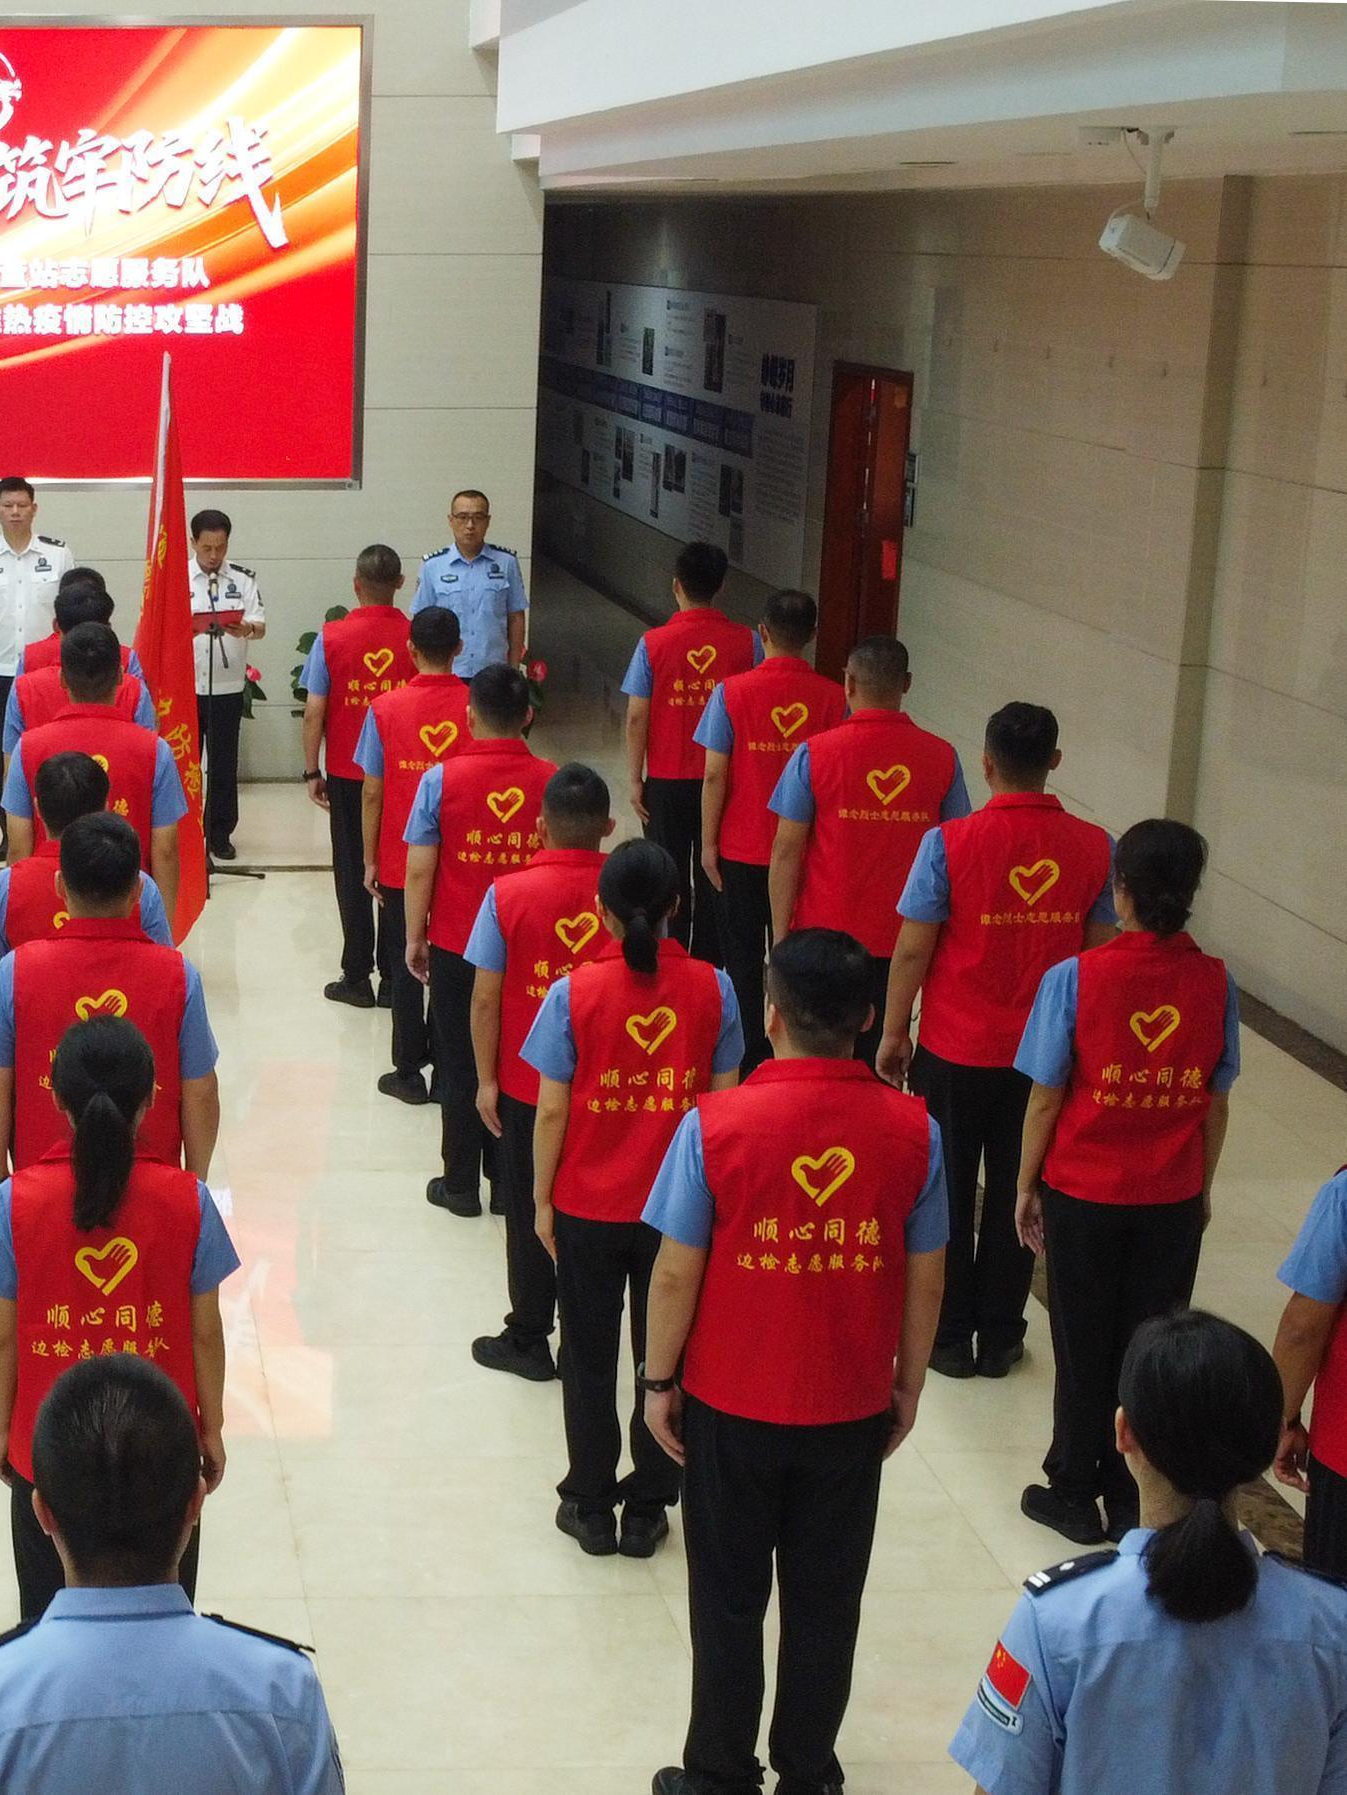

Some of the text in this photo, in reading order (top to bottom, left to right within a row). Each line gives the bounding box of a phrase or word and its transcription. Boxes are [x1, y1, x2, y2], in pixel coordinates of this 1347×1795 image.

[753, 1216, 881, 1246] 顺心同德
[46, 1300, 165, 1333] 顺心同德
